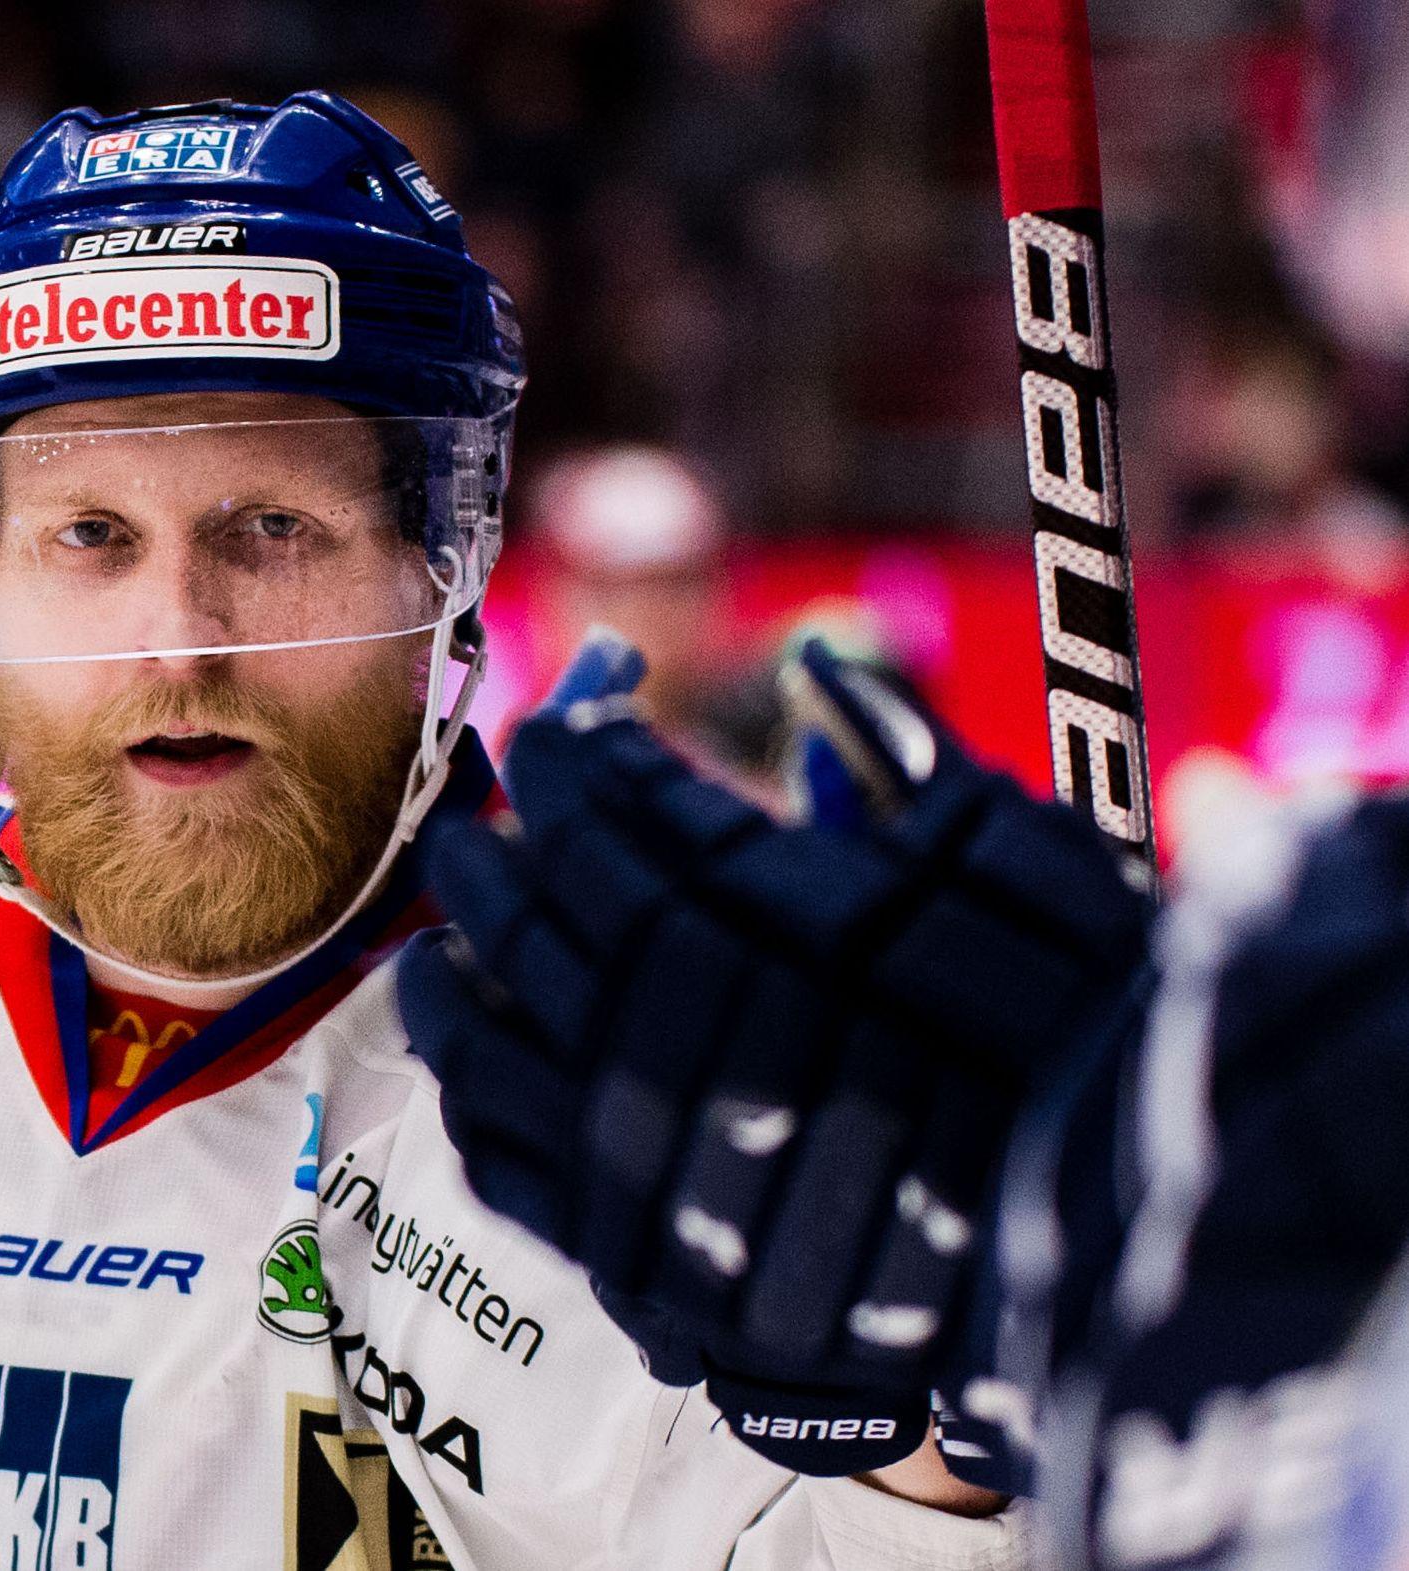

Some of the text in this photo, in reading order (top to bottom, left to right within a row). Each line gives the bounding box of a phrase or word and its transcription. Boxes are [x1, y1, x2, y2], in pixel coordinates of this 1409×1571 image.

[69, 225, 239, 261] BAUER
[1008, 211, 1147, 843] BAUE
[742, 1412, 897, 1441] BAUER
